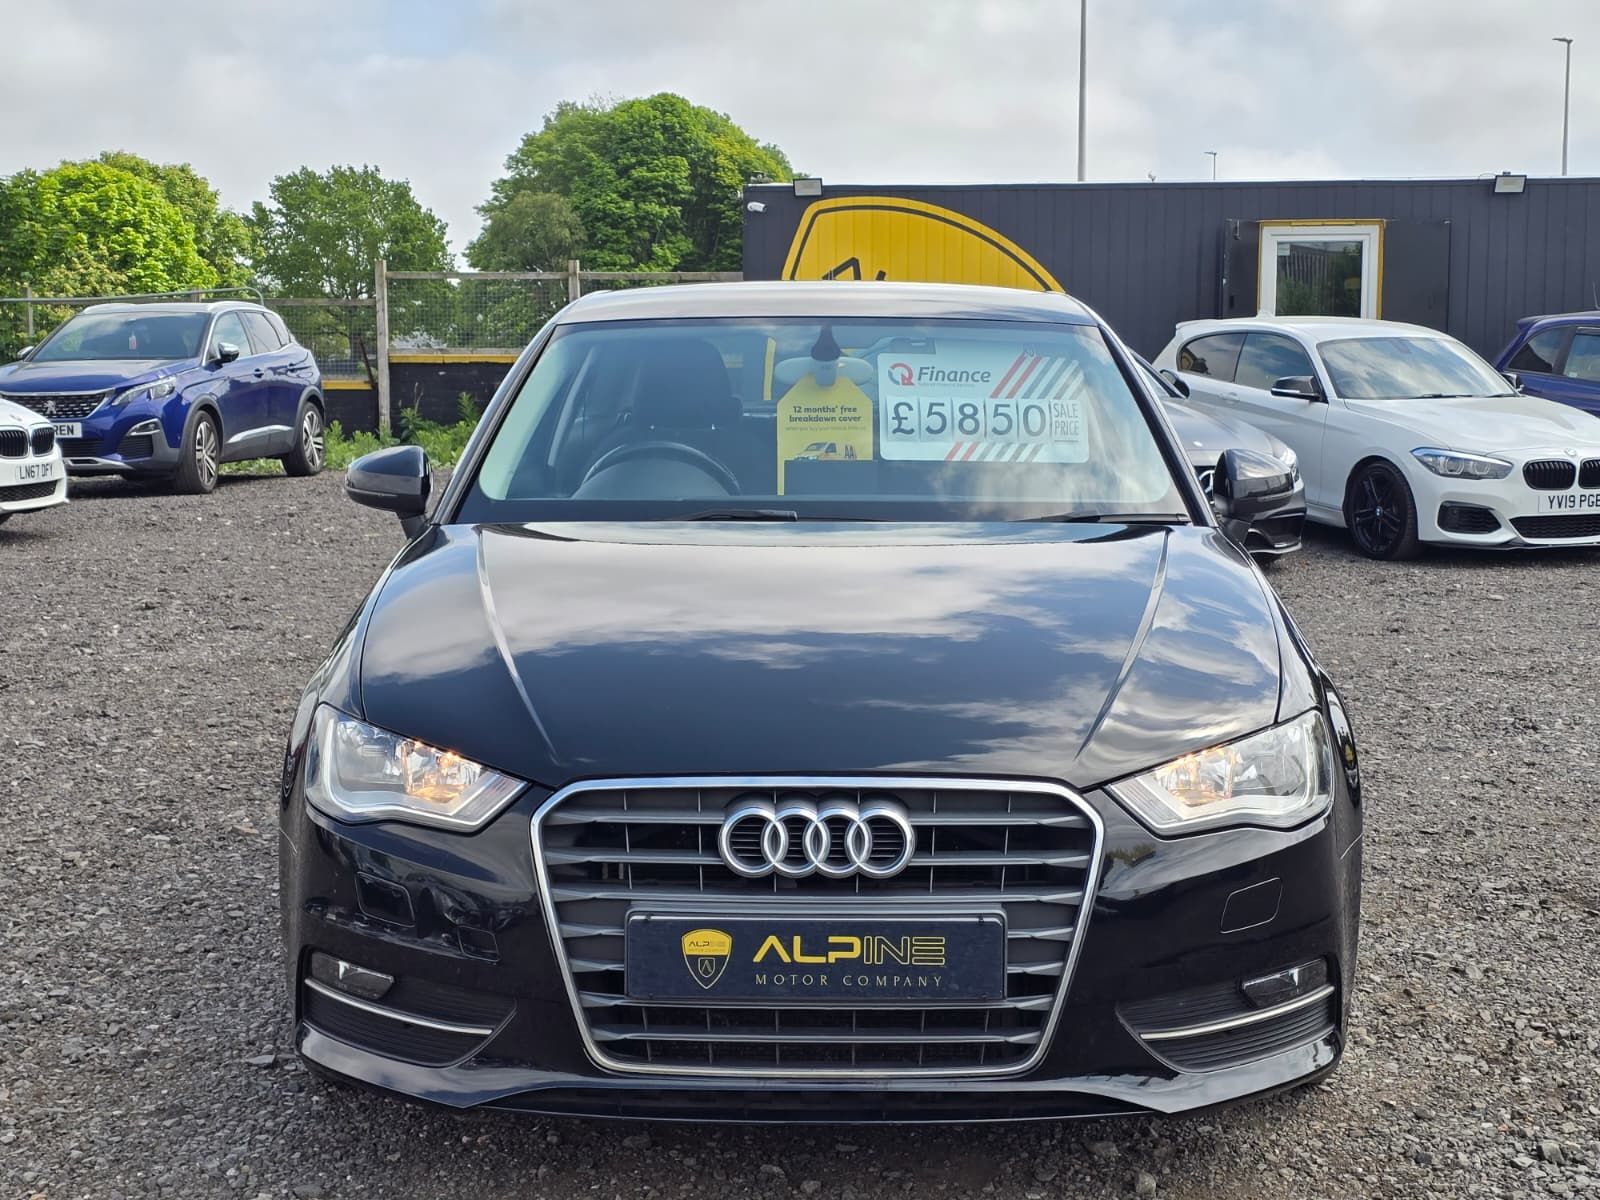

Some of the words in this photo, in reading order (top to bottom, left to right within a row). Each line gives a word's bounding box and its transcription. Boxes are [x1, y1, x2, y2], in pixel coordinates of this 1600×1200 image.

[917, 366, 991, 383] Finance
[793, 405, 803, 414] 12
[840, 405, 857, 414] free
[1054, 403, 1079, 419] SALE
[789, 414, 837, 423] breakdown
[891, 401, 1047, 437] £5850
[1054, 420, 1080, 436] PRICE
[19, 464, 40, 480] LN67
[1547, 494, 1576, 510] YV19
[752, 935, 946, 966] ALPINE
[755, 974, 829, 986] MOTOR
[842, 974, 943, 988] COMPANY
